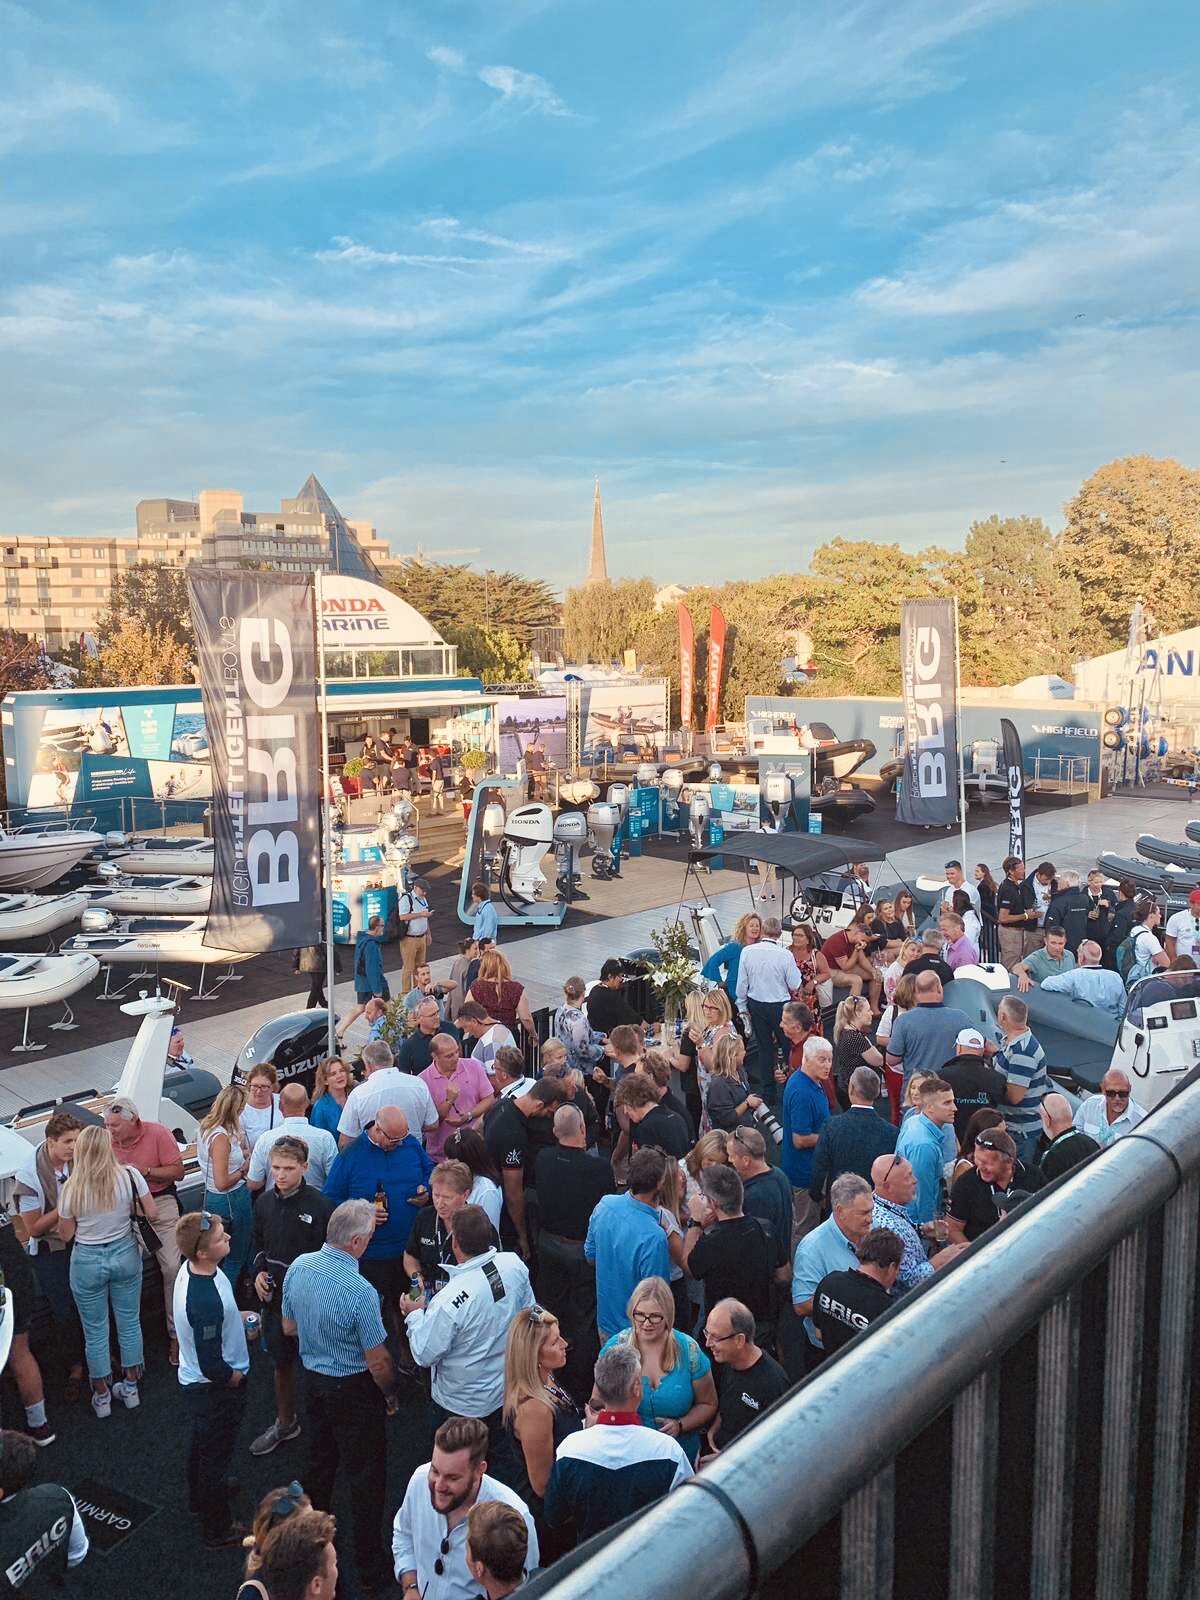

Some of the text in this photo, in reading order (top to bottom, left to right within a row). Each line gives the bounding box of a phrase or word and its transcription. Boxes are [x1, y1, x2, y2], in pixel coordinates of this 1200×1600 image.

[1041, 725, 1098, 737] HIGHFIELD
[819, 1293, 870, 1330] BRIG
[5, 1516, 67, 1585] BRIG
